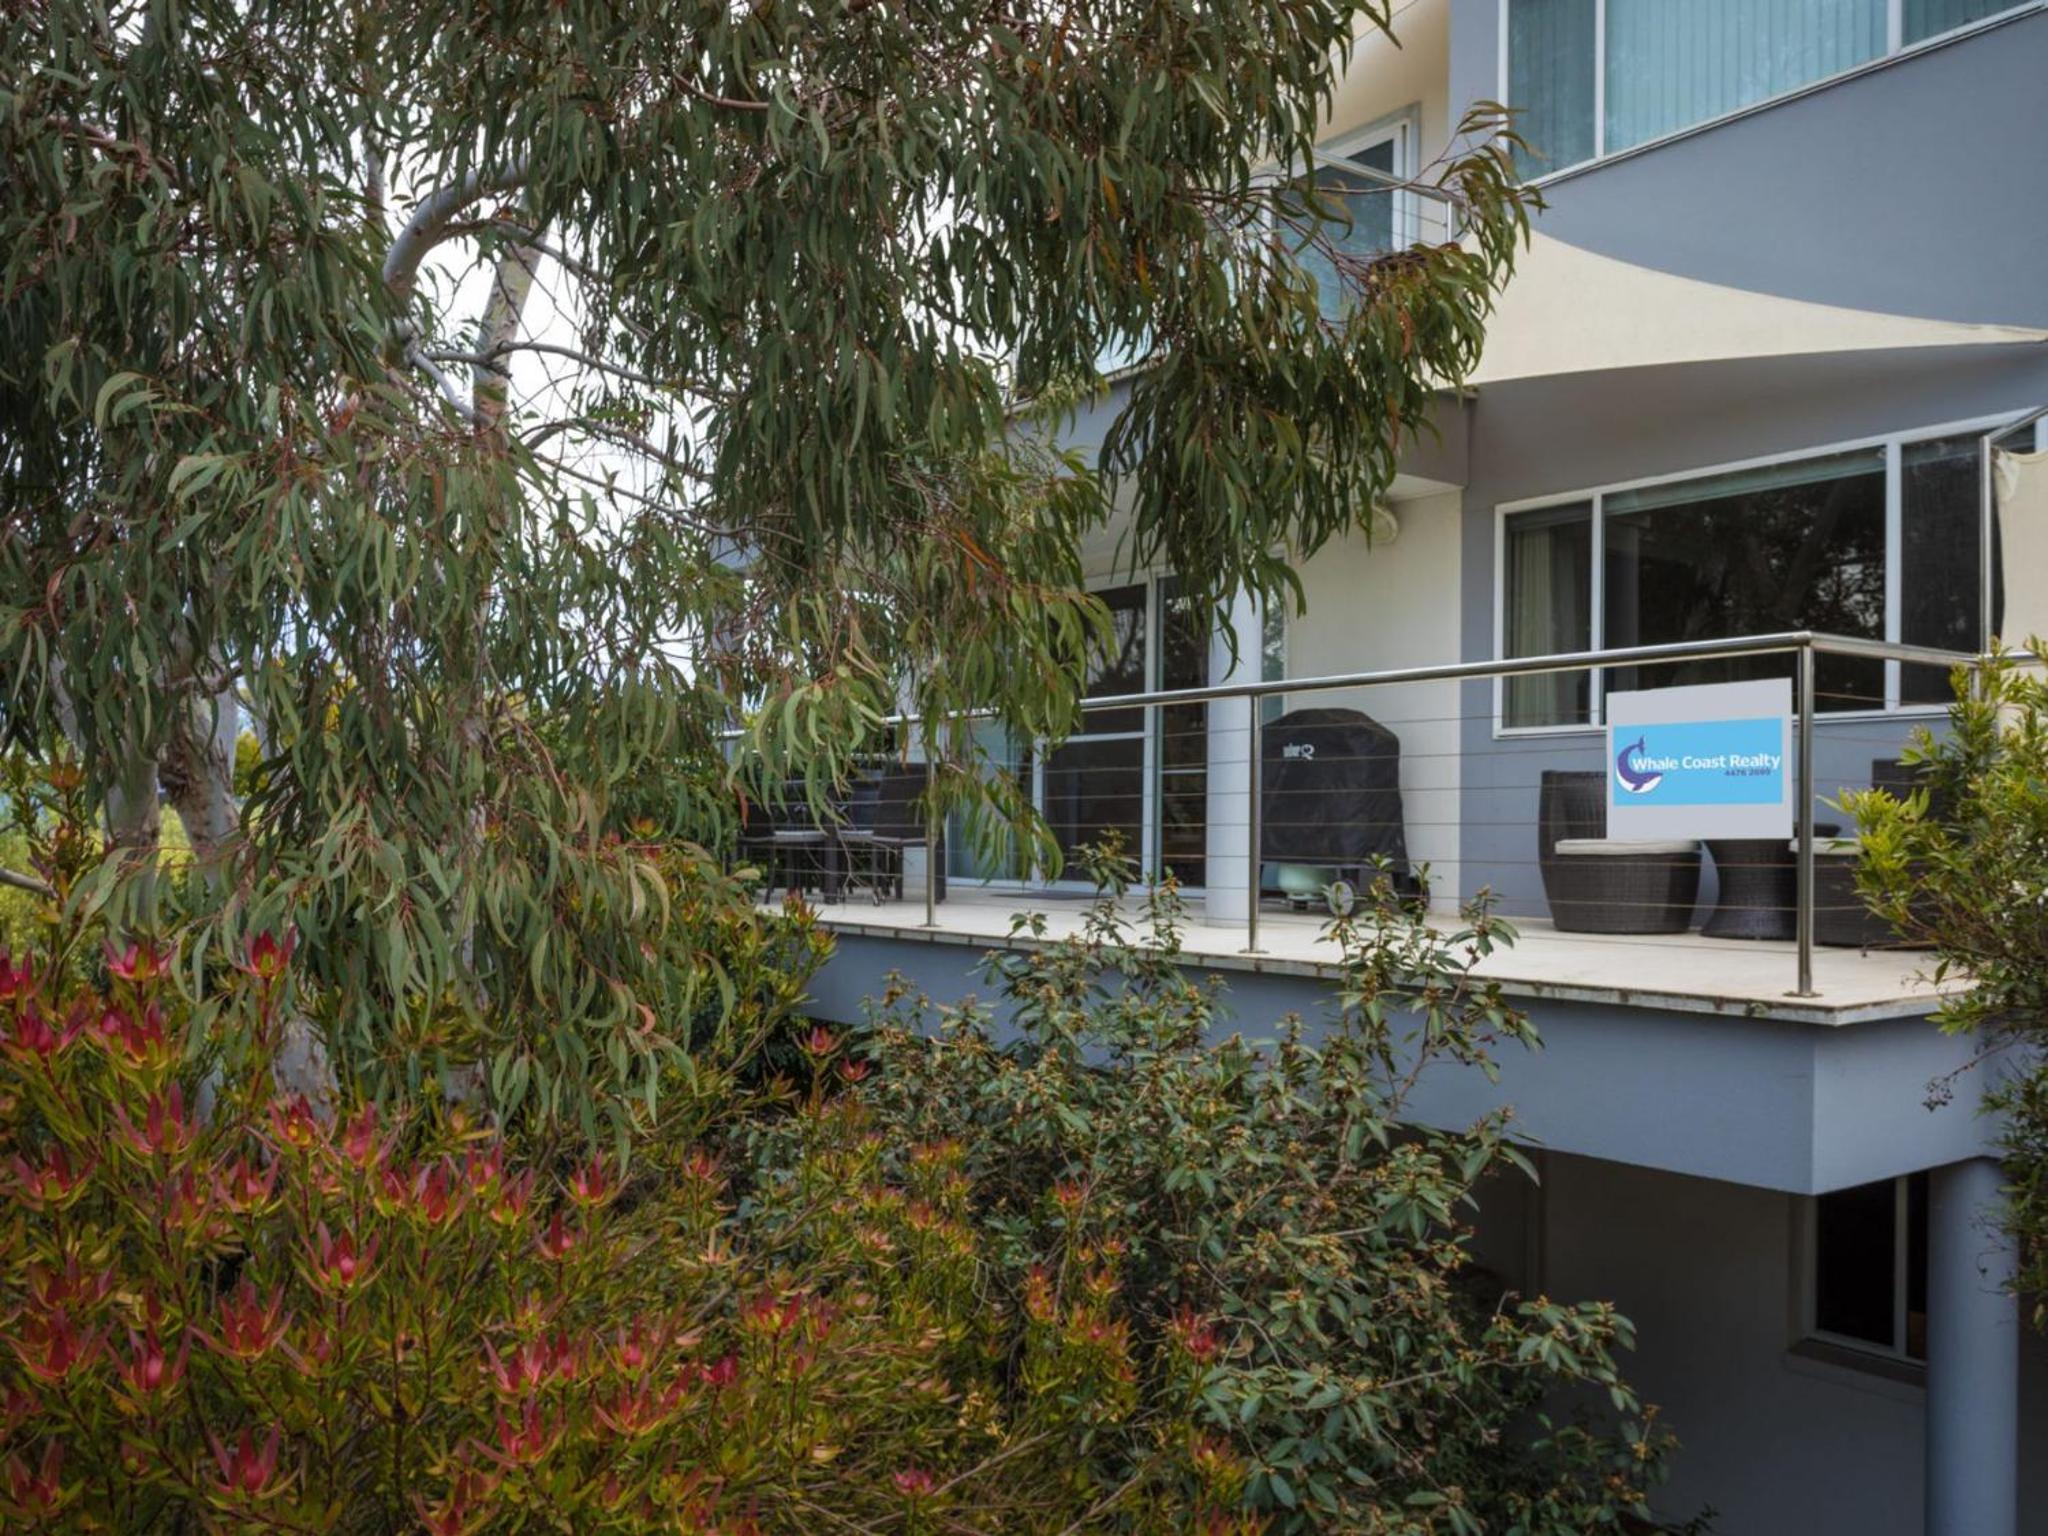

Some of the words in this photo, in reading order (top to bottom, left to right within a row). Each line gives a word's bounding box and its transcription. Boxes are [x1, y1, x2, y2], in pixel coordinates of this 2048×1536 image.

[1632, 757, 1678, 770] Whale
[1682, 755, 1726, 769] Coast
[1730, 753, 1781, 769] Realty
